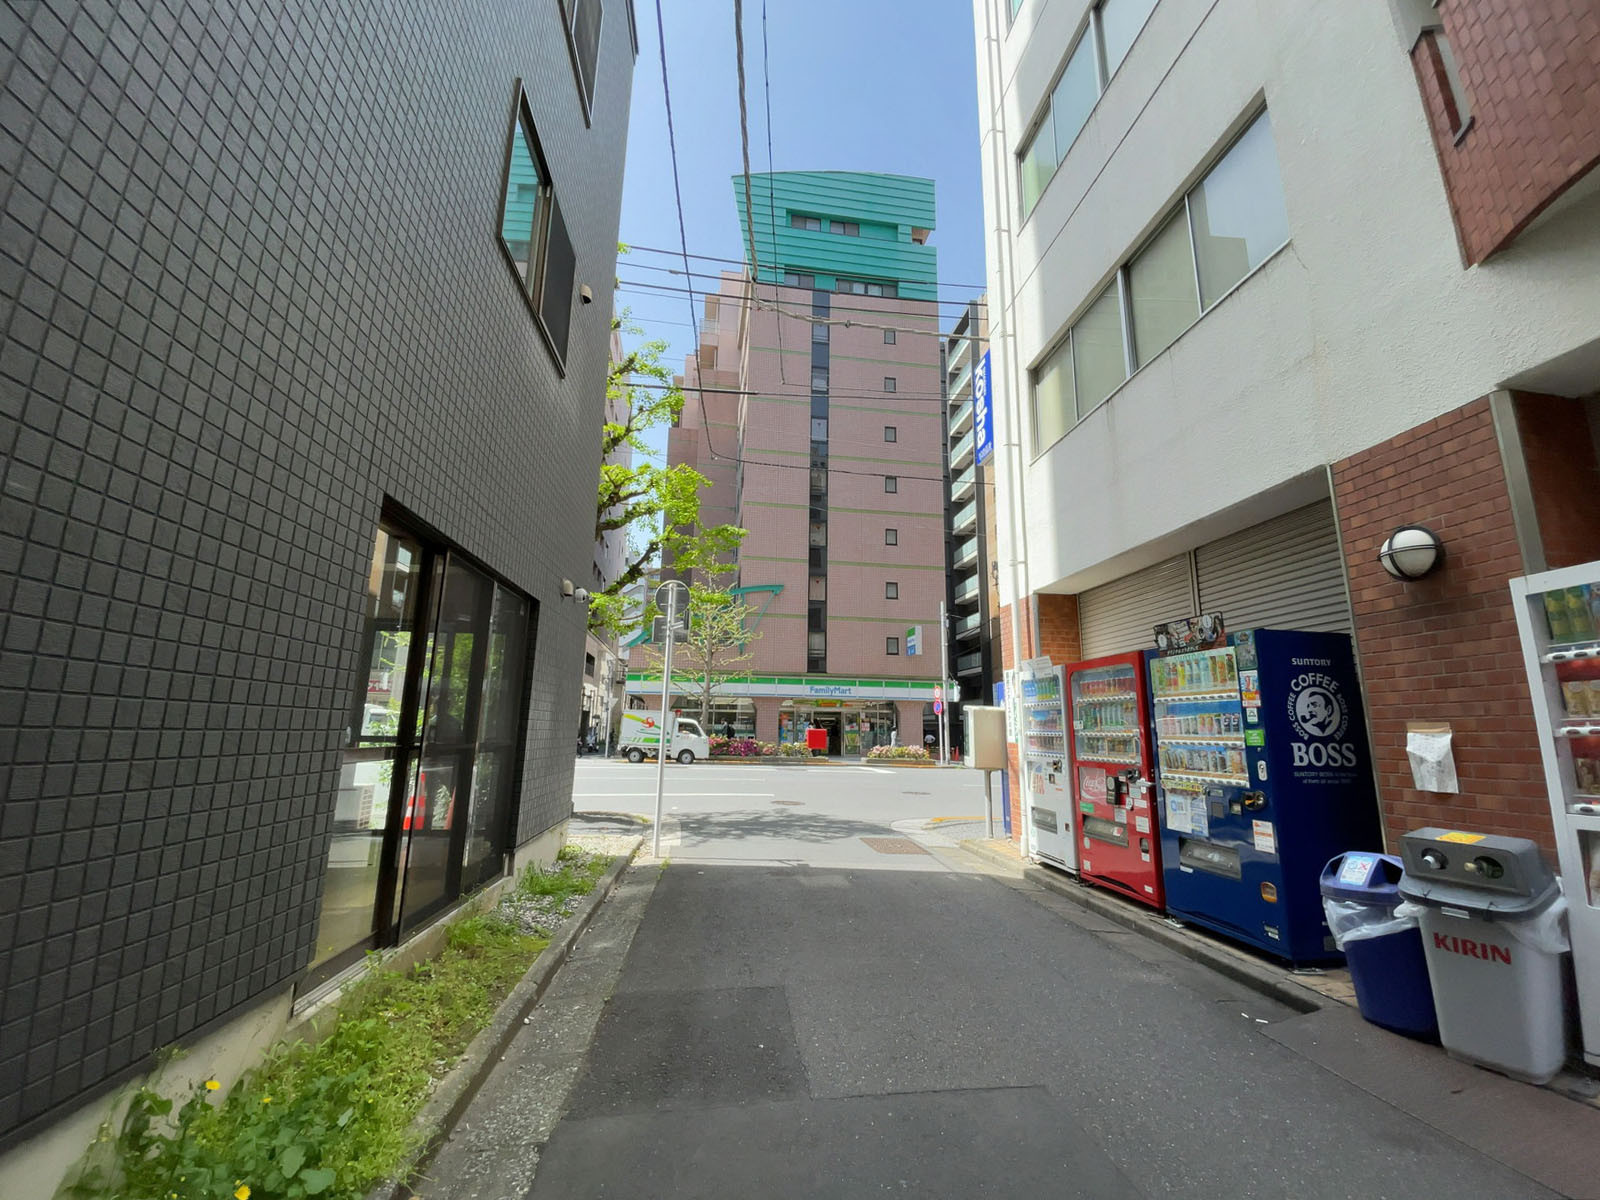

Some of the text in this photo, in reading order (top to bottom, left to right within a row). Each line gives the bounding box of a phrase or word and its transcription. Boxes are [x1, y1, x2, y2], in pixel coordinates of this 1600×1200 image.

[1291, 657, 1332, 667] SUNTORY
[810, 686, 852, 696] FamilyMart
[1290, 672, 1340, 692] COFFEE
[1290, 742, 1357, 767] BOSS
[1433, 931, 1512, 965] KIRIN
